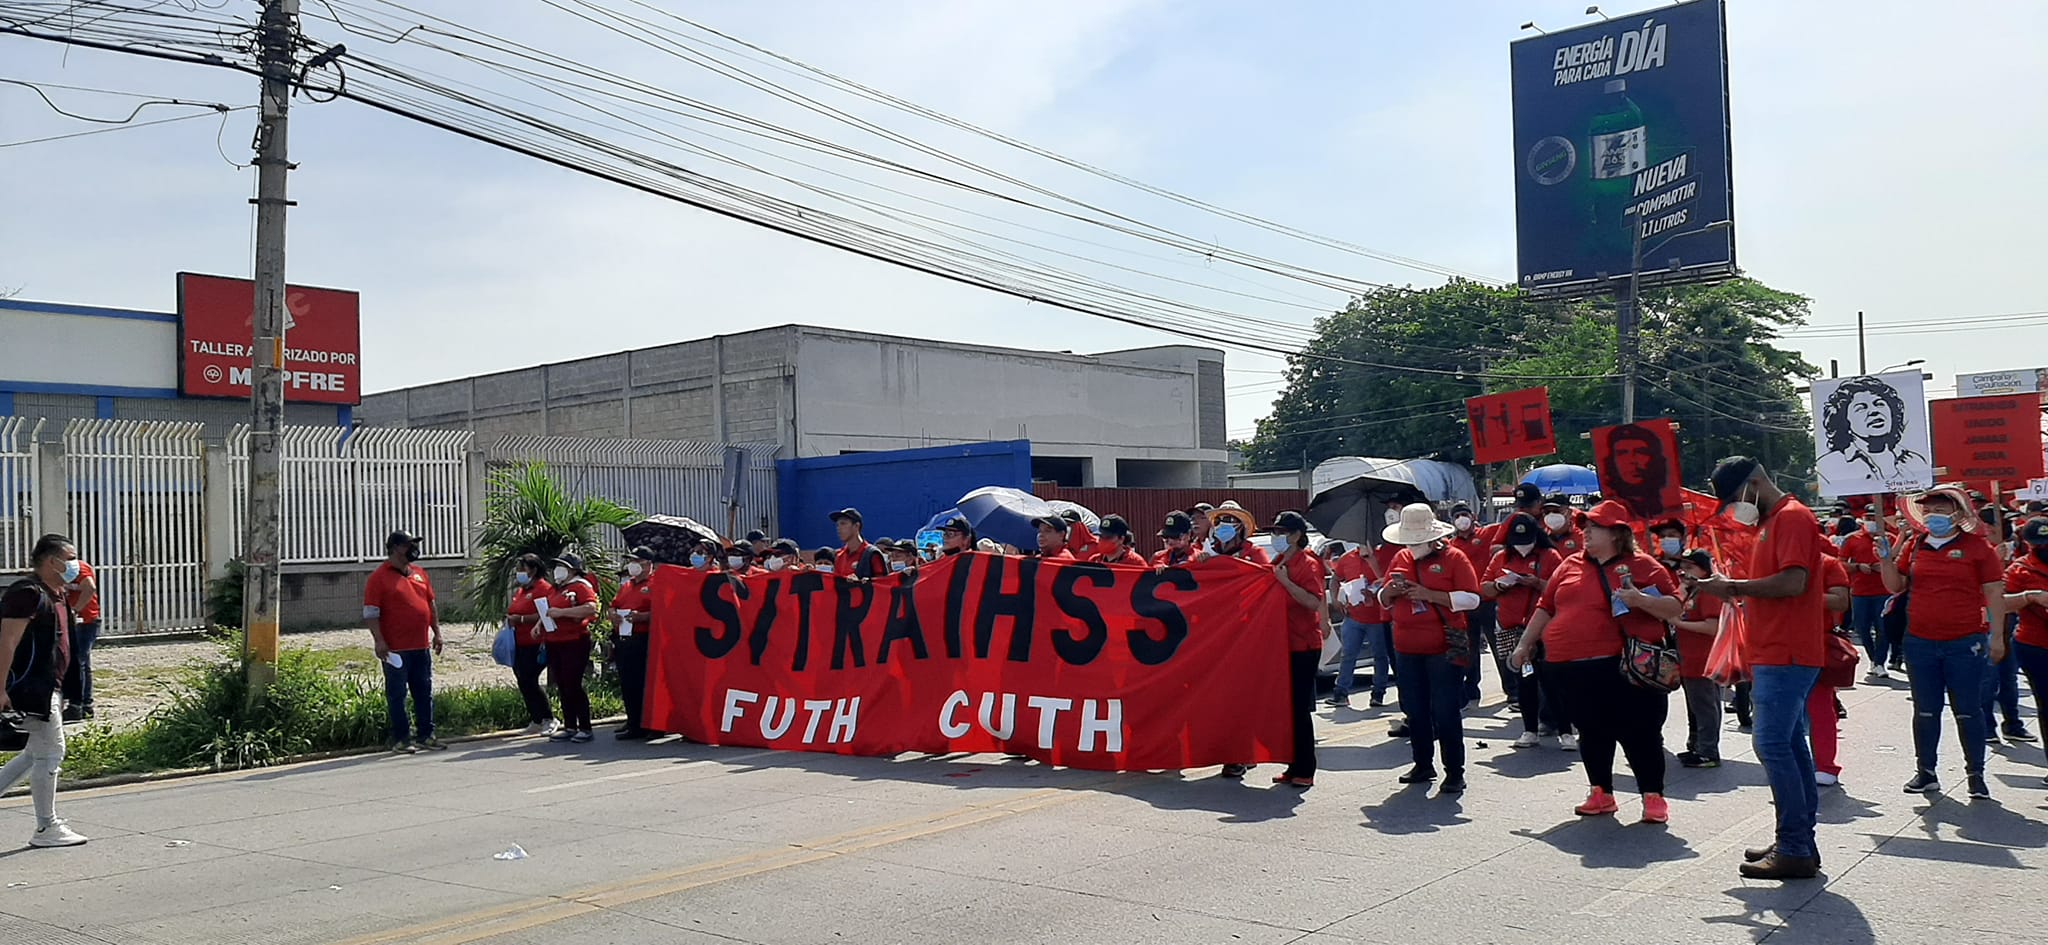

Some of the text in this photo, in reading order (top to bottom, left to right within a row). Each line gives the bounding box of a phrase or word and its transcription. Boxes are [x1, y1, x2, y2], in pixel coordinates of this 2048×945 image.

[1553, 19, 1667, 75] ENERGÍA DÍA
[1554, 60, 1611, 87] PARA CADA
[1633, 154, 1687, 197] NUEVA
[1637, 181, 1697, 216] COMPARTIR
[1653, 208, 1688, 235] LITROS
[190, 340, 356, 365] TALLER ARIZADO POR
[229, 366, 345, 392] MPFRE
[695, 552, 1198, 671] SITRAIHSS
[721, 688, 1122, 753] FUTH CUTH
